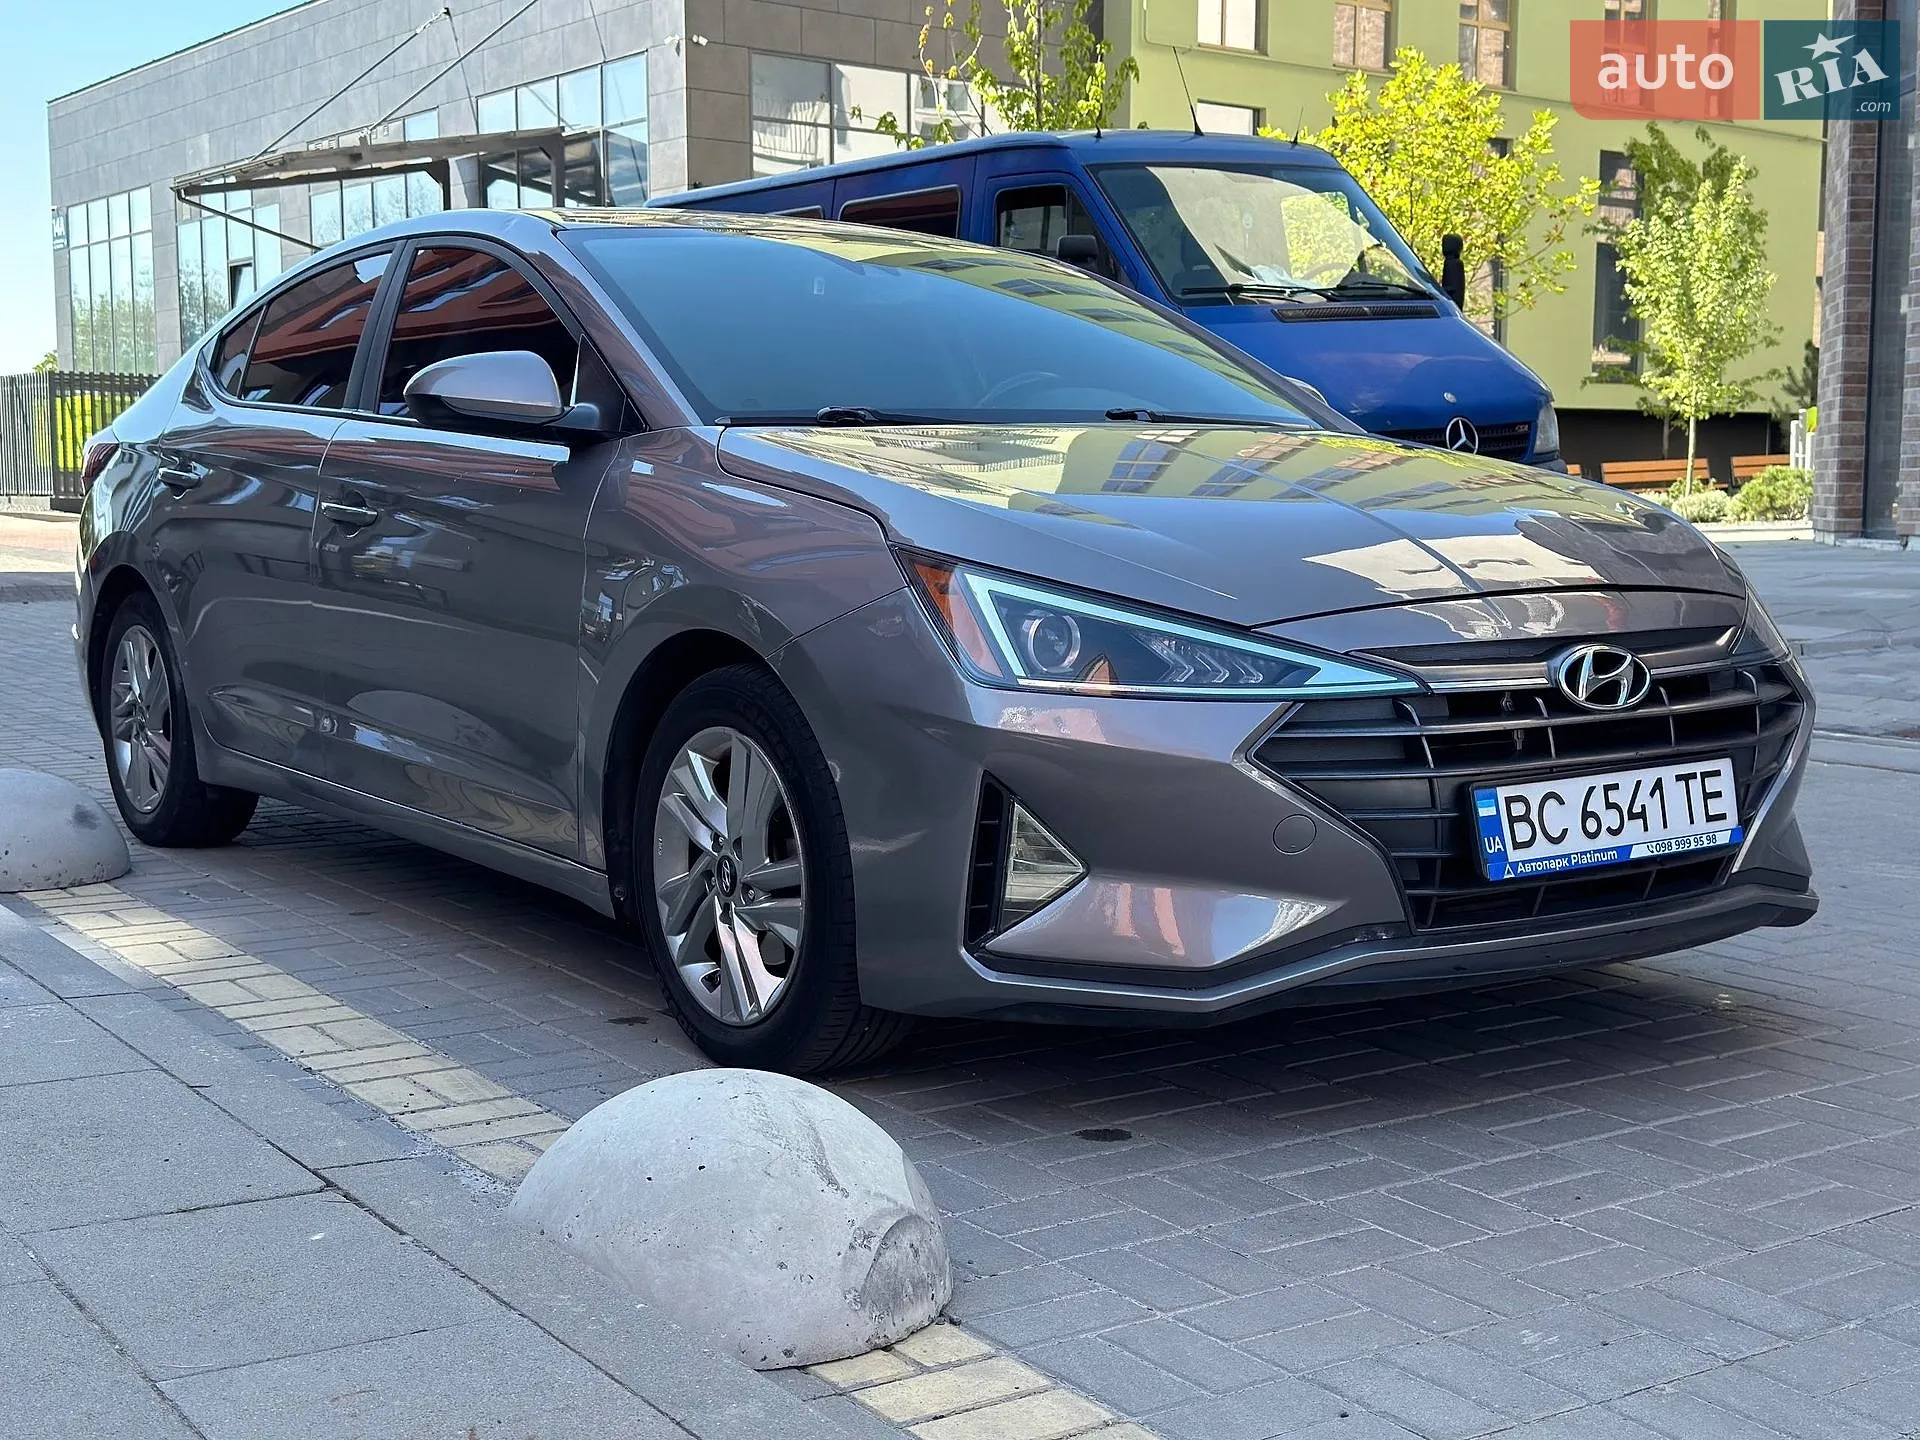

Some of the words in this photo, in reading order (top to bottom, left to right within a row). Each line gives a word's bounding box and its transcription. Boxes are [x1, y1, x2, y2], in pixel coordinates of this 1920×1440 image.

[1504, 791, 1569, 850] BC
[1581, 777, 1668, 840] 6541
[1675, 769, 1727, 825] TE
[1484, 835, 1505, 853] UA
[1655, 841, 1673, 853] 098
[1674, 837, 1692, 850] 999
[1693, 835, 1705, 847] 95
[1705, 833, 1717, 845] 98
[1517, 858, 1569, 874] Автопарк
[1571, 850, 1618, 865] Platinum
